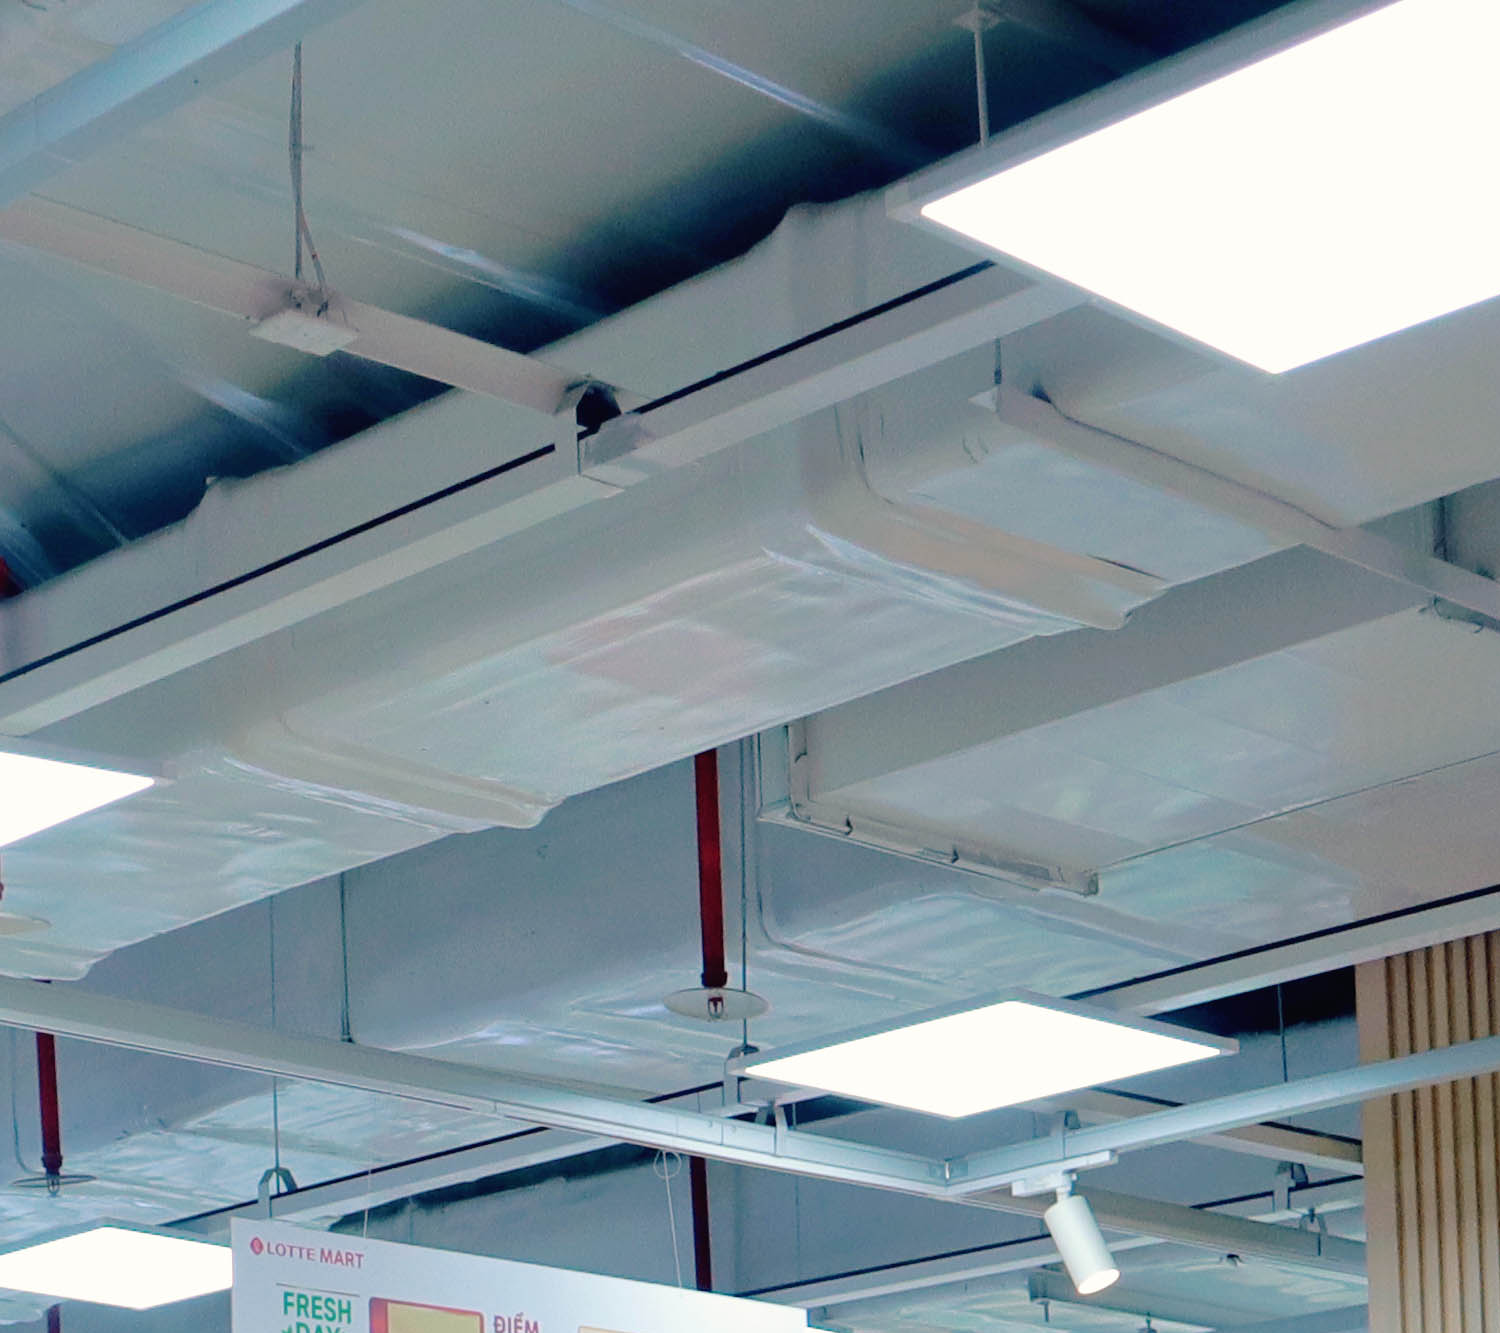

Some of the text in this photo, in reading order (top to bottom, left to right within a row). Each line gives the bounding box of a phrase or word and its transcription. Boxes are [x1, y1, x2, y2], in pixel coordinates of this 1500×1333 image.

[266, 1242, 364, 1268] LOTTE MART
[283, 1292, 351, 1324] FRESH
